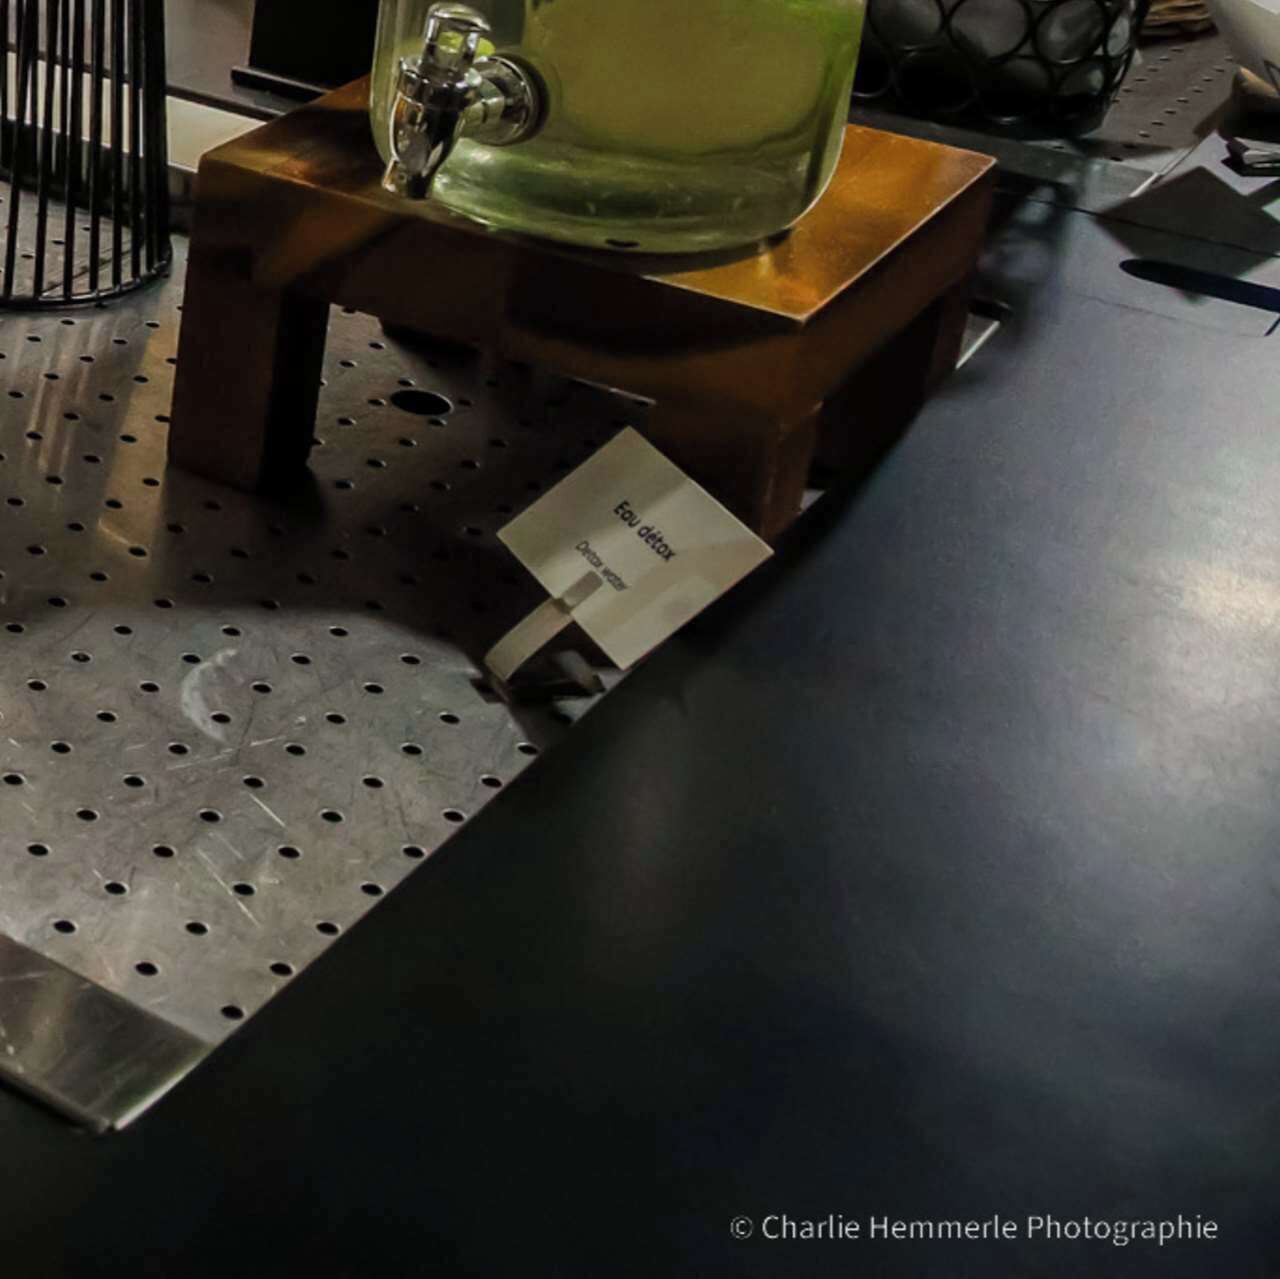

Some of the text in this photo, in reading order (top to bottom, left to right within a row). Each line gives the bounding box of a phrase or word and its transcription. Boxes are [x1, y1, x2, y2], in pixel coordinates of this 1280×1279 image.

[613, 500, 676, 562] Eau détox
[575, 540, 604, 570] Detox
